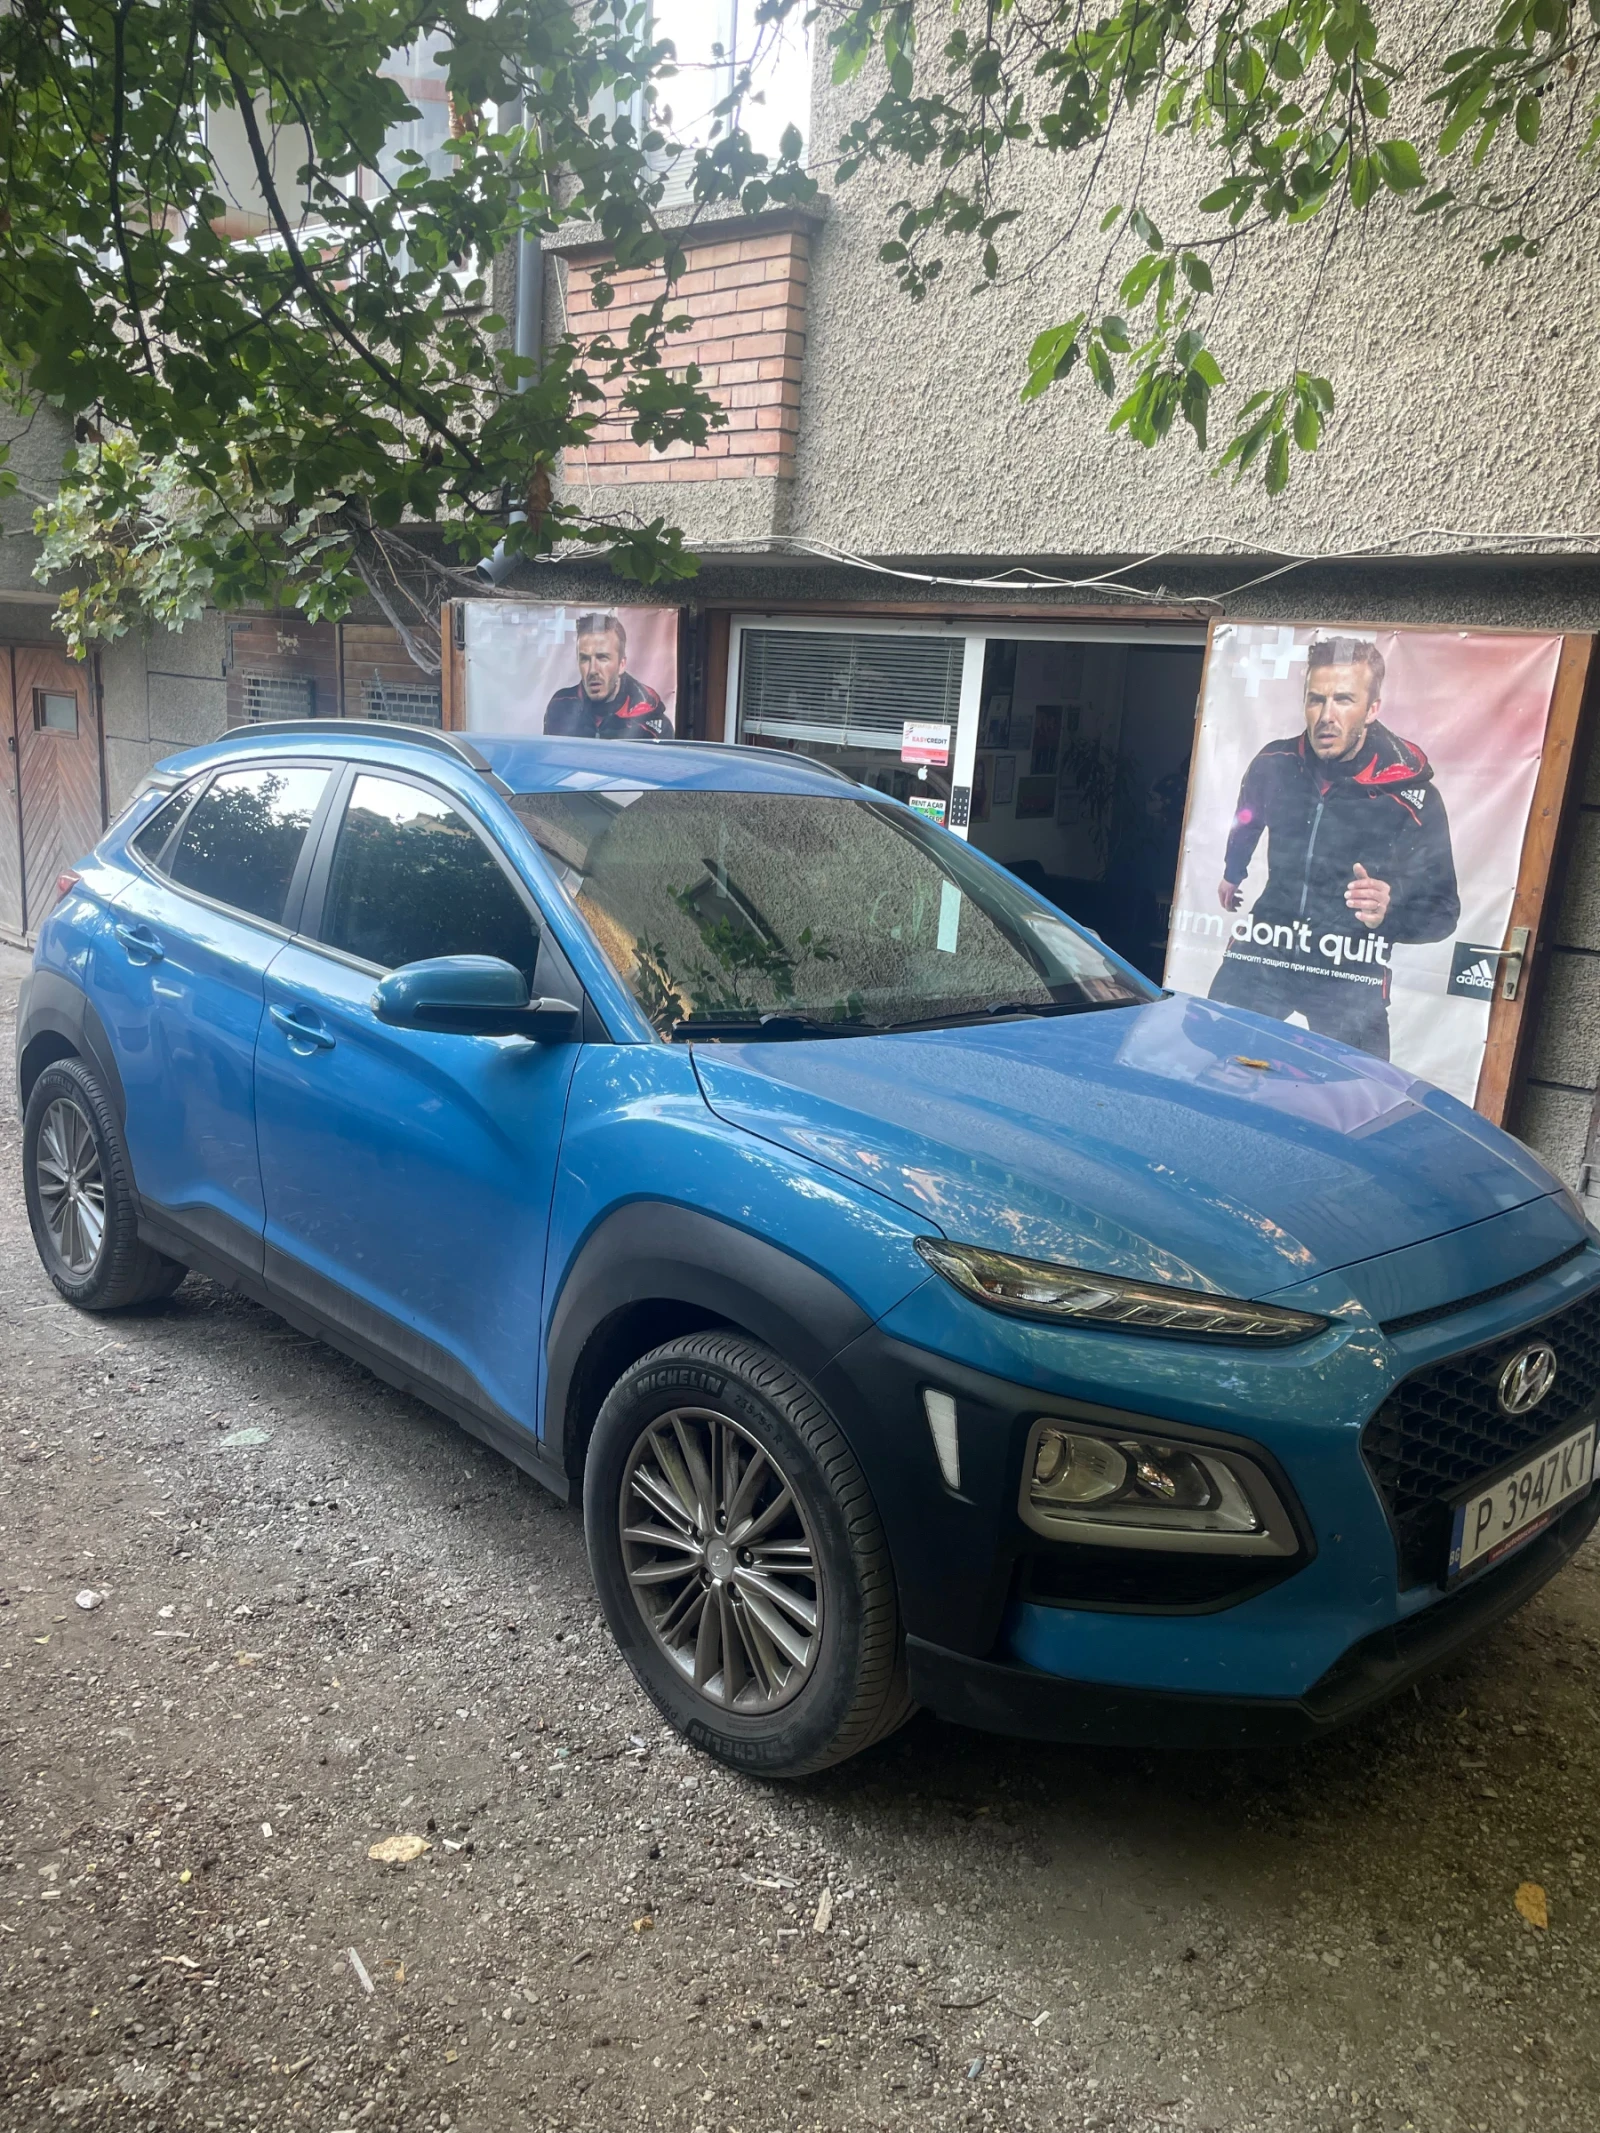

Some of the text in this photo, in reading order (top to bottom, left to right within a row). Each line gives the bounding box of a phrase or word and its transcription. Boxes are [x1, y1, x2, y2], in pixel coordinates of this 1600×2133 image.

[911, 799, 926, 807] RENT
[1400, 790, 1424, 810] adidas
[1230, 913, 1312, 953] don't
[1319, 932, 1389, 967] quit
[1262, 957, 1290, 969] защита
[1290, 963, 1306, 973] при
[1306, 966, 1330, 976] ниски
[1331, 969, 1383, 986] температури
[636, 1369, 722, 1394] MICHELIN
[1448, 1546, 1461, 1566] BG
[689, 1724, 779, 1761] MICHELIN
